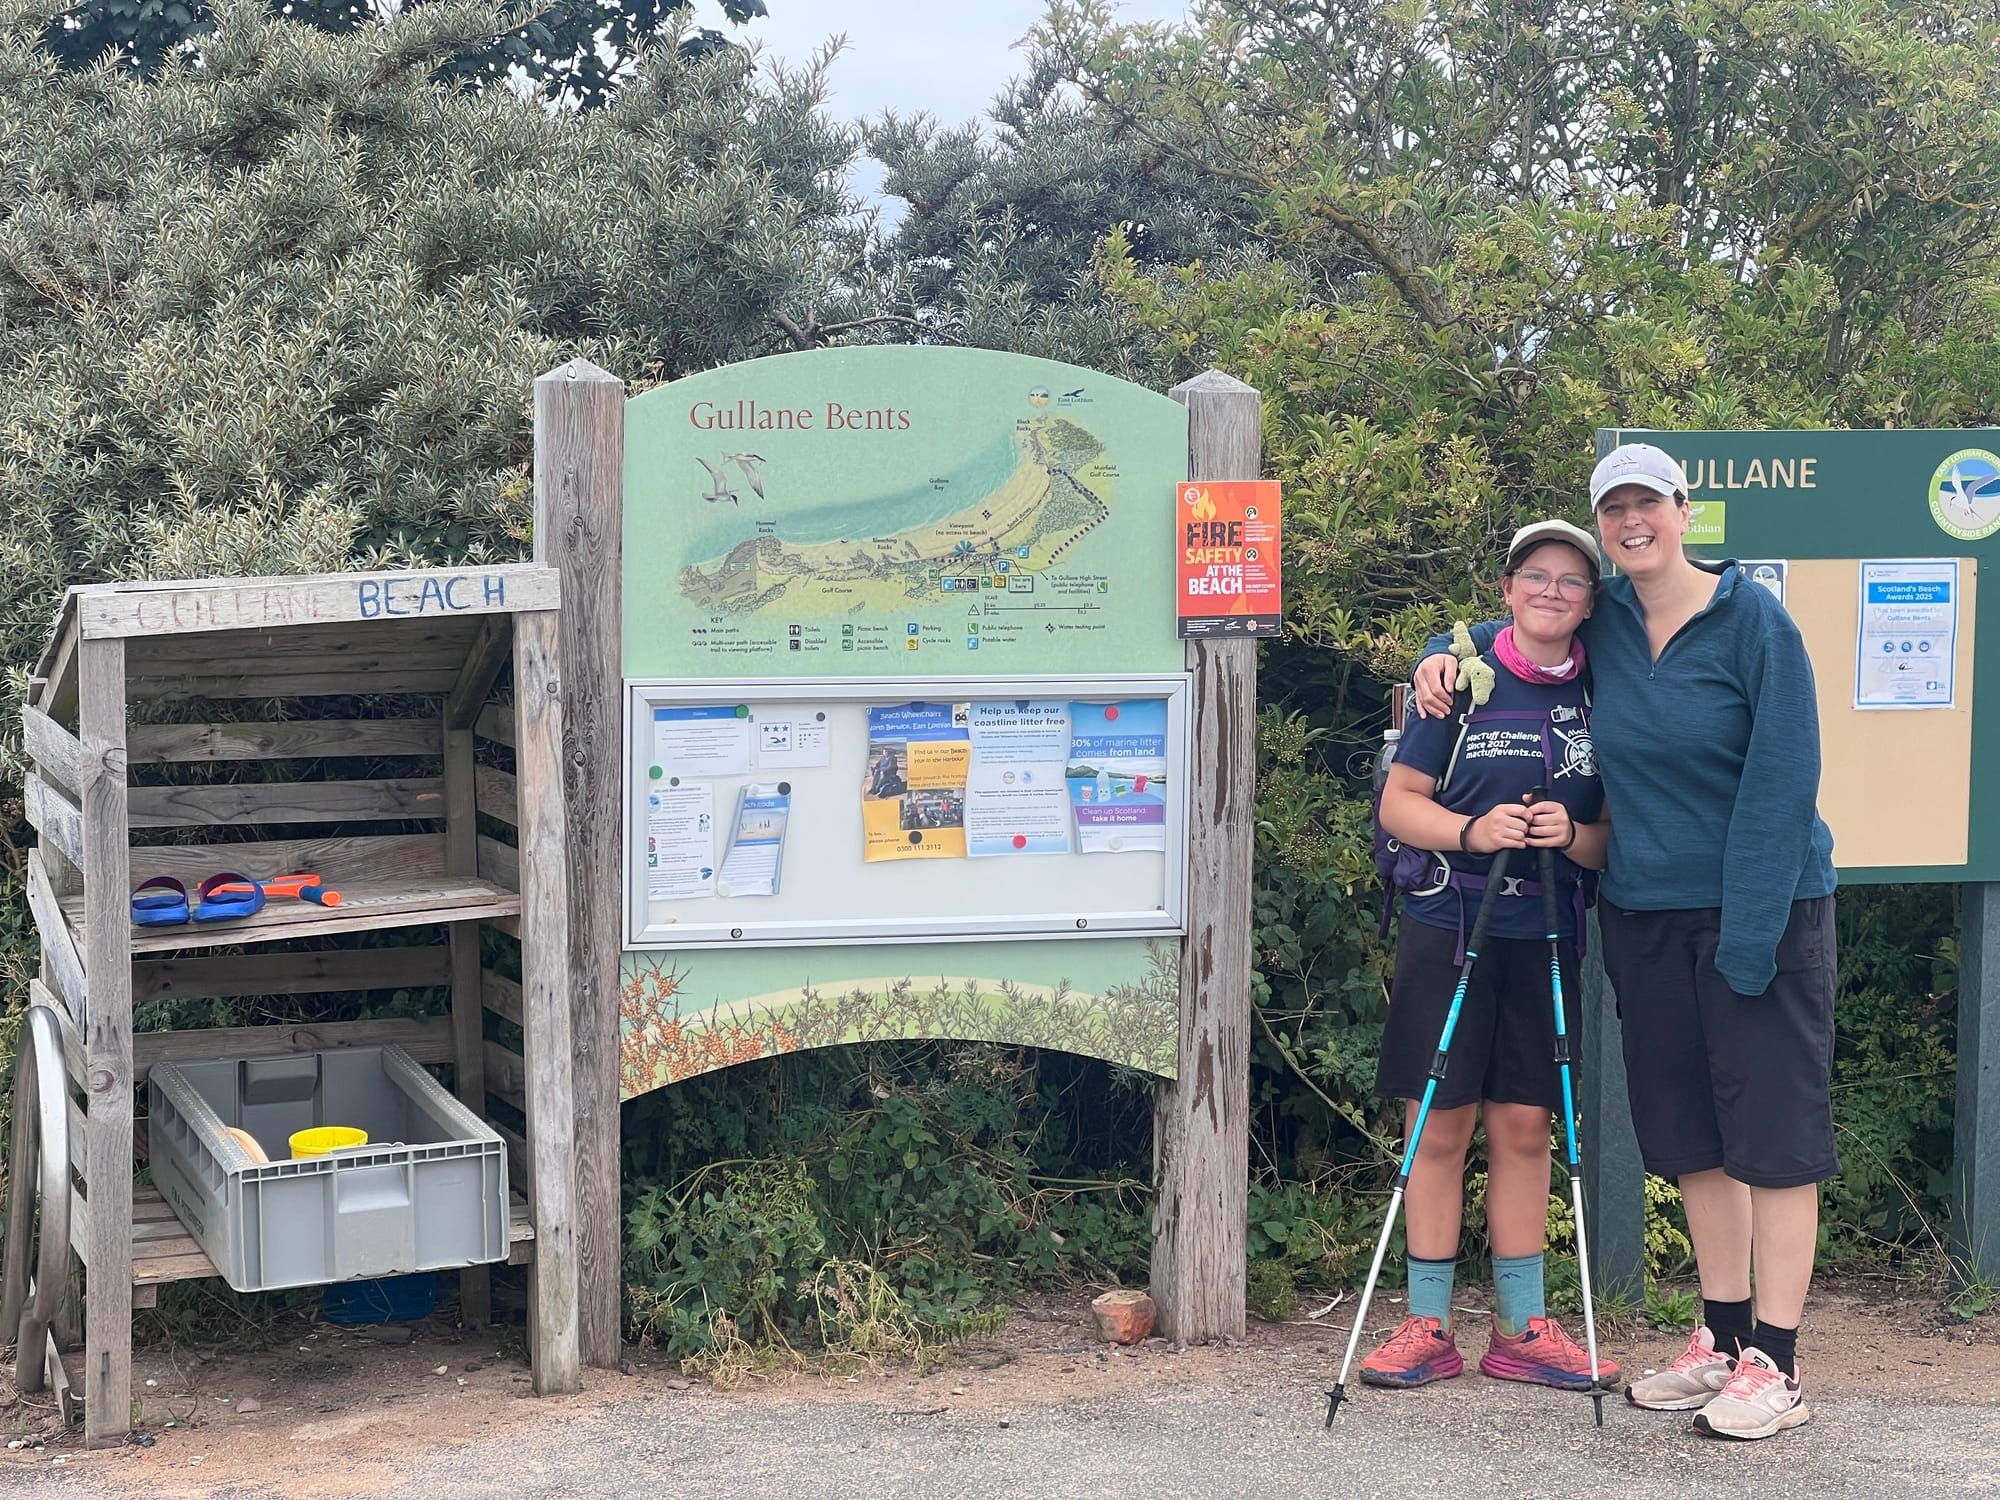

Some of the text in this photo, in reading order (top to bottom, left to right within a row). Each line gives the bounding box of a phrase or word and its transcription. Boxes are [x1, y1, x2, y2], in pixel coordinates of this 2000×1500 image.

[689, 400, 911, 430] Gullane Bents
[1681, 458, 1817, 490] ULLANE
[1932, 501, 1982, 537] COUNTRYSIDE
[1186, 520, 1243, 548] FIRE
[1687, 524, 1721, 534] othian
[1184, 548, 1242, 565] SAFETY
[1206, 565, 1222, 577] AT
[1222, 564, 1244, 576] THE
[1188, 577, 1243, 596] BEACH
[357, 574, 505, 619] BEACH
[980, 708, 1002, 716] Help
[1018, 707, 1041, 716] keep
[974, 718, 1018, 726] coastline
[1046, 718, 1065, 726] free
[1093, 738, 1104, 746] of
[1106, 738, 1138, 747] marine
[1140, 737, 1162, 746] litter
[1466, 731, 1500, 742] MacTuff
[1487, 740, 1510, 748] 2017
[1110, 748, 1132, 756] from
[1134, 748, 1156, 756] land
[1082, 807, 1102, 815] Clean
[1104, 808, 1114, 816] up
